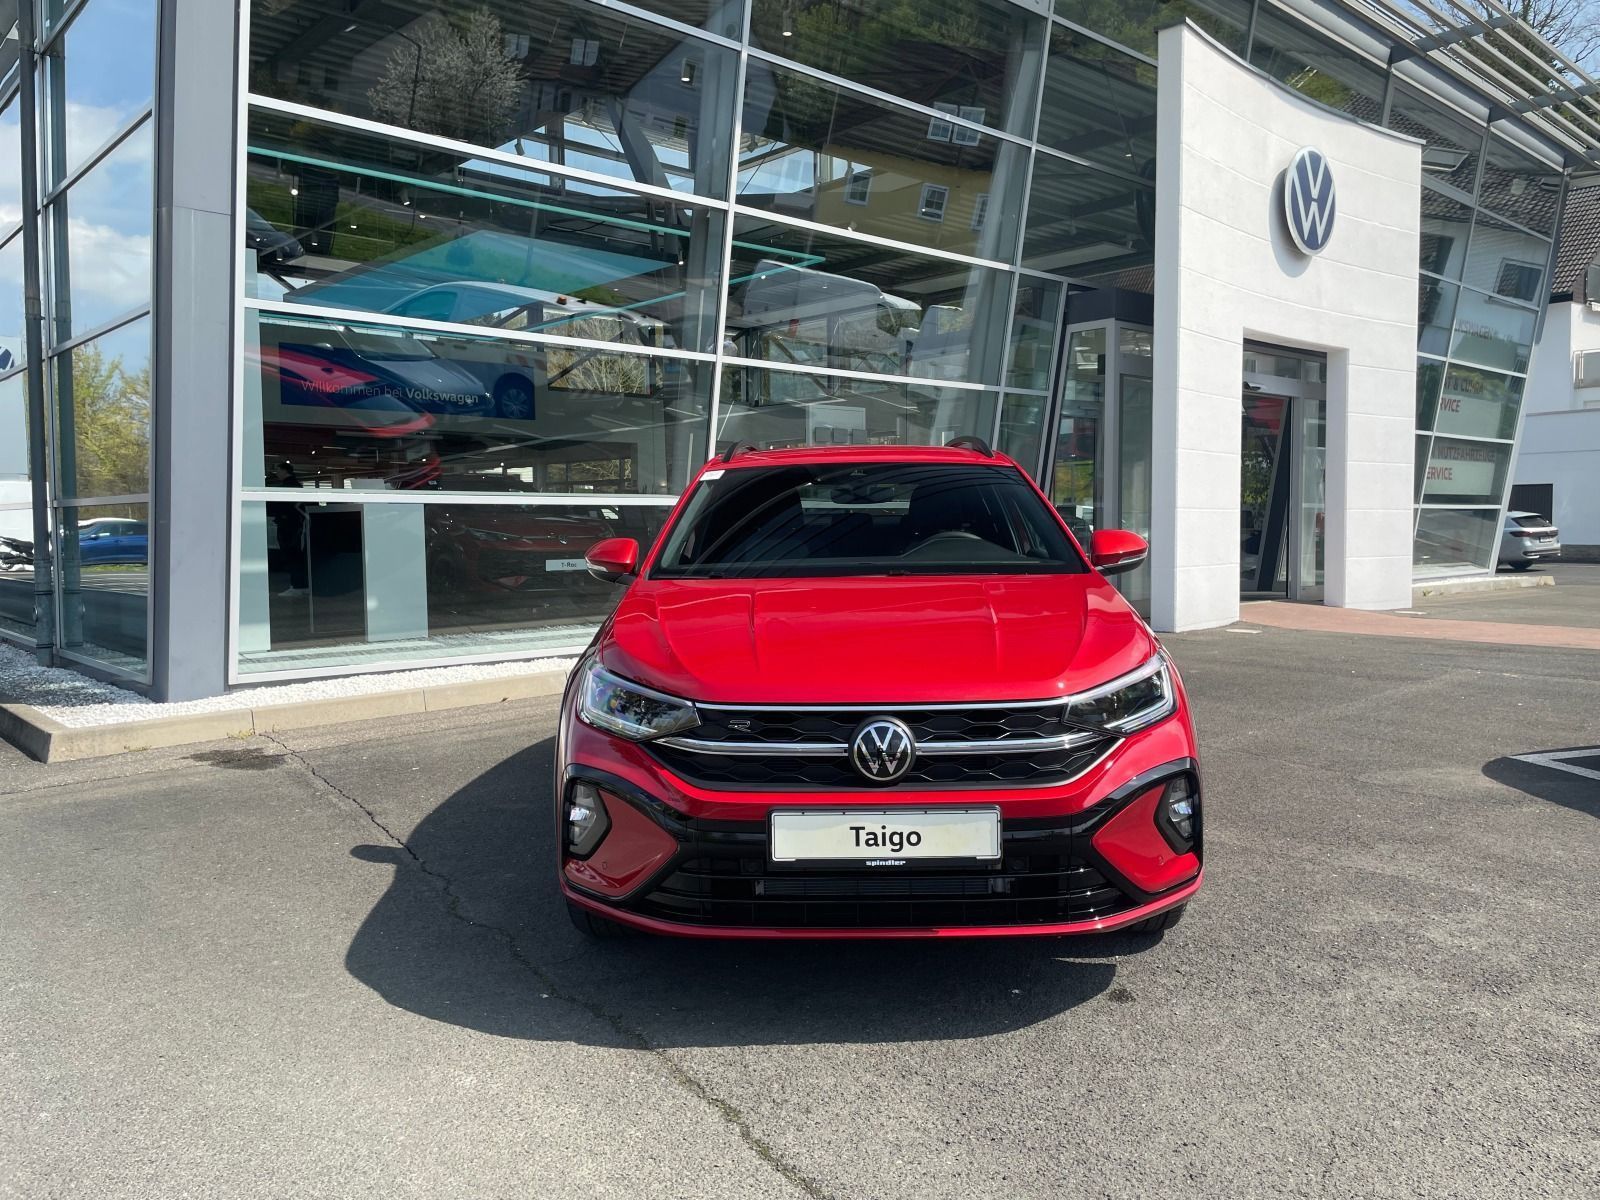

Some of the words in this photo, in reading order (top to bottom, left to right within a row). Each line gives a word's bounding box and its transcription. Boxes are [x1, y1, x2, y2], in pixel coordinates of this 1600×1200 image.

[1288, 147, 1335, 250] VW
[301, 380, 381, 397] Willkommen
[384, 385, 402, 398] bei
[405, 387, 479, 405] Volkswagen
[856, 721, 909, 777] VW
[849, 825, 922, 852] Taigo
[865, 859, 906, 867] spindler
